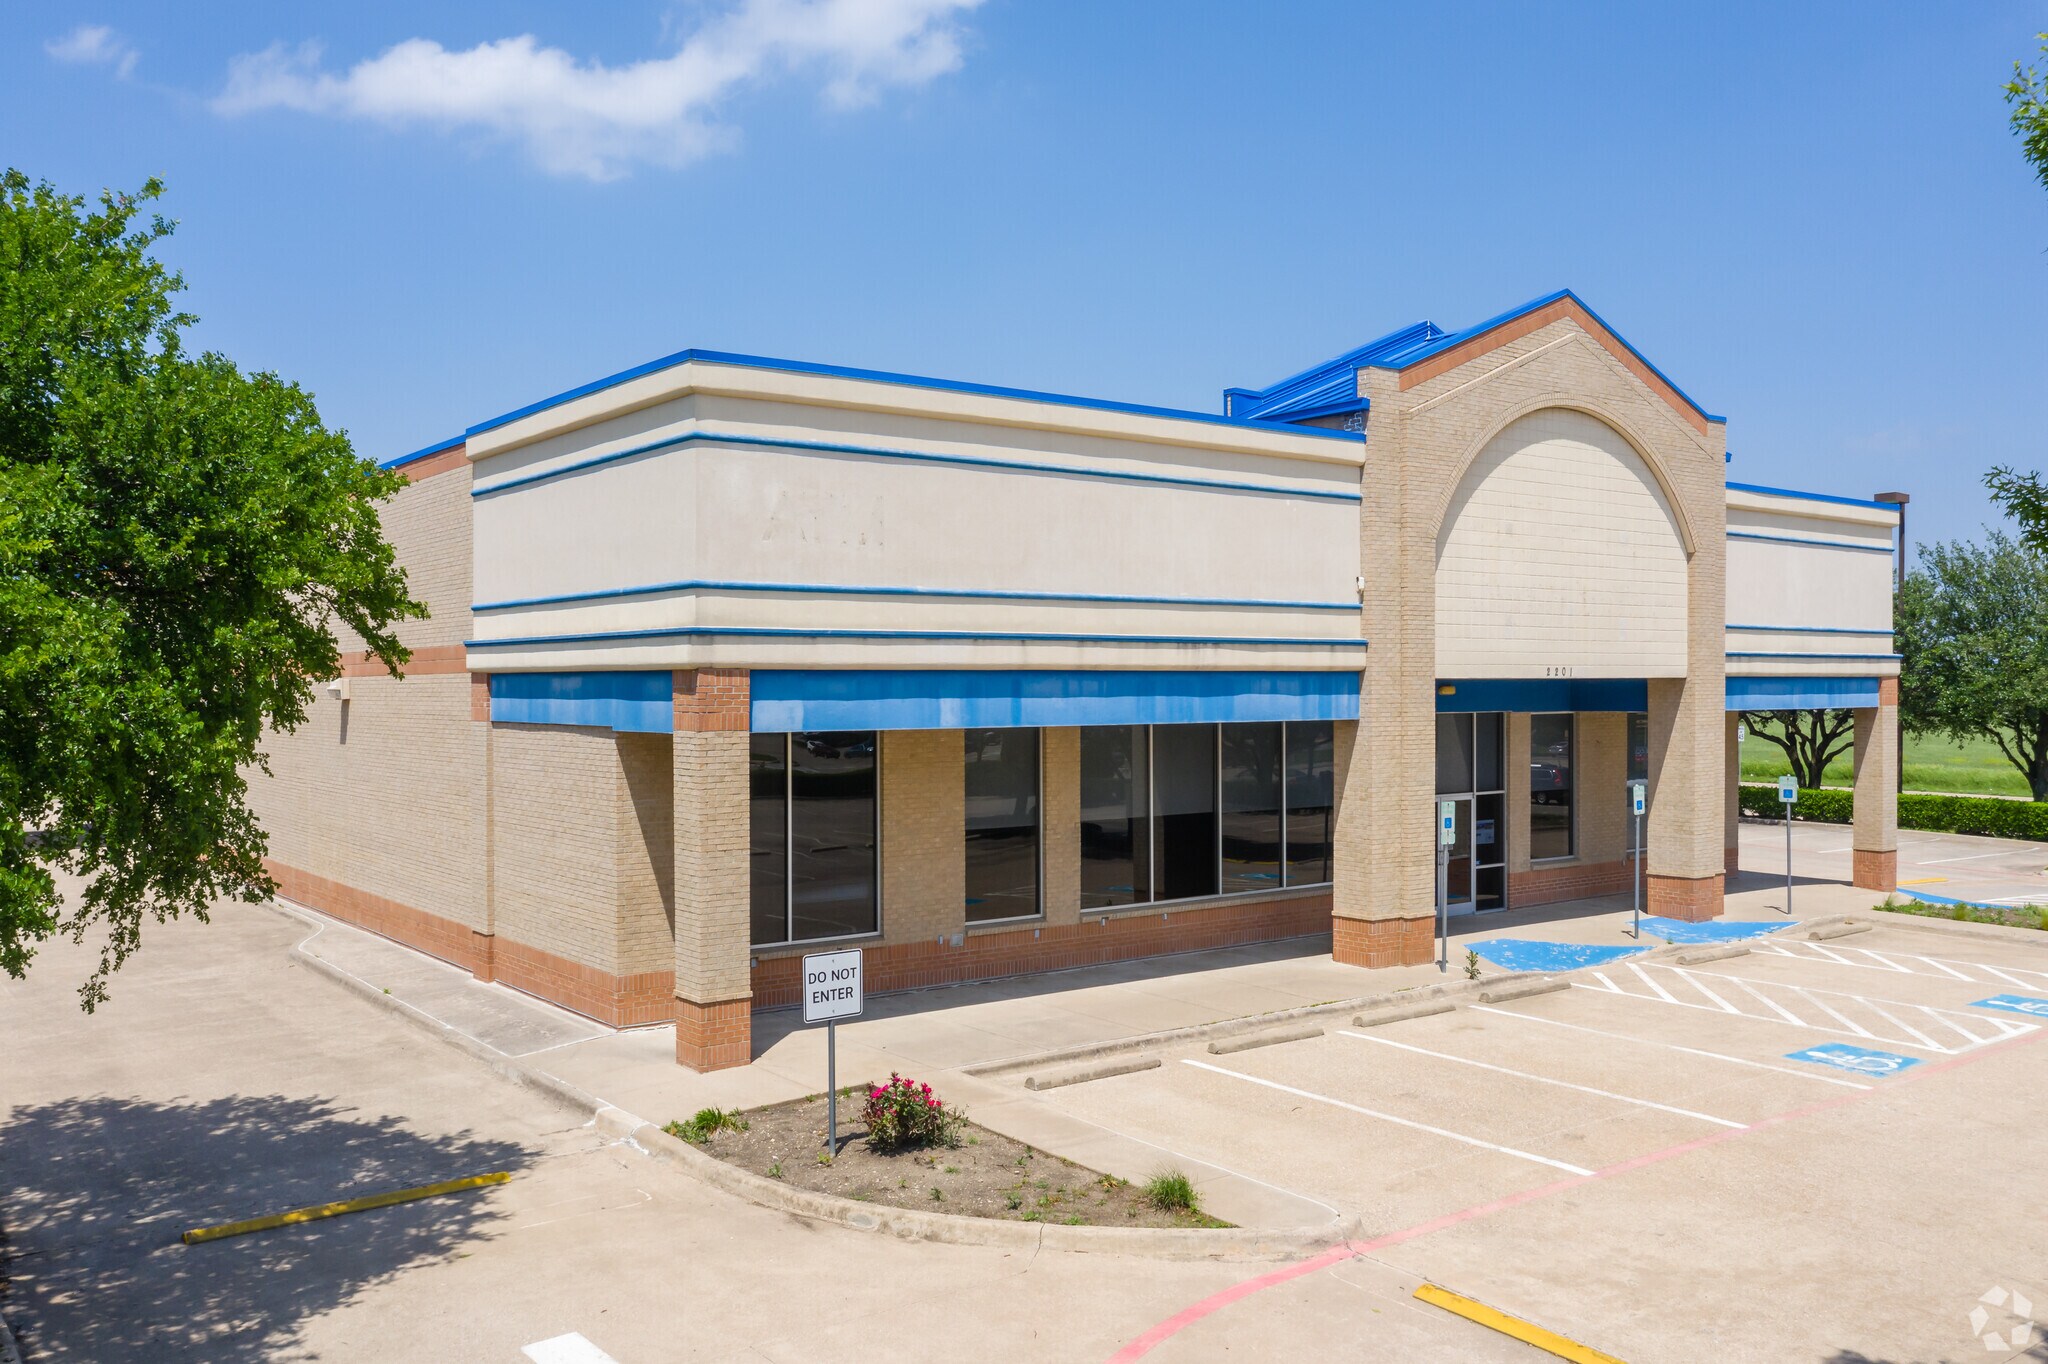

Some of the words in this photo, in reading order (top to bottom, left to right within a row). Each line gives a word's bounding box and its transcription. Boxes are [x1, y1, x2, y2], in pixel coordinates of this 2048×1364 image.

[1546, 667, 1572, 677] 2201
[808, 971, 827, 985] DO
[831, 967, 857, 981] NOT
[812, 986, 854, 1004] ENTER
